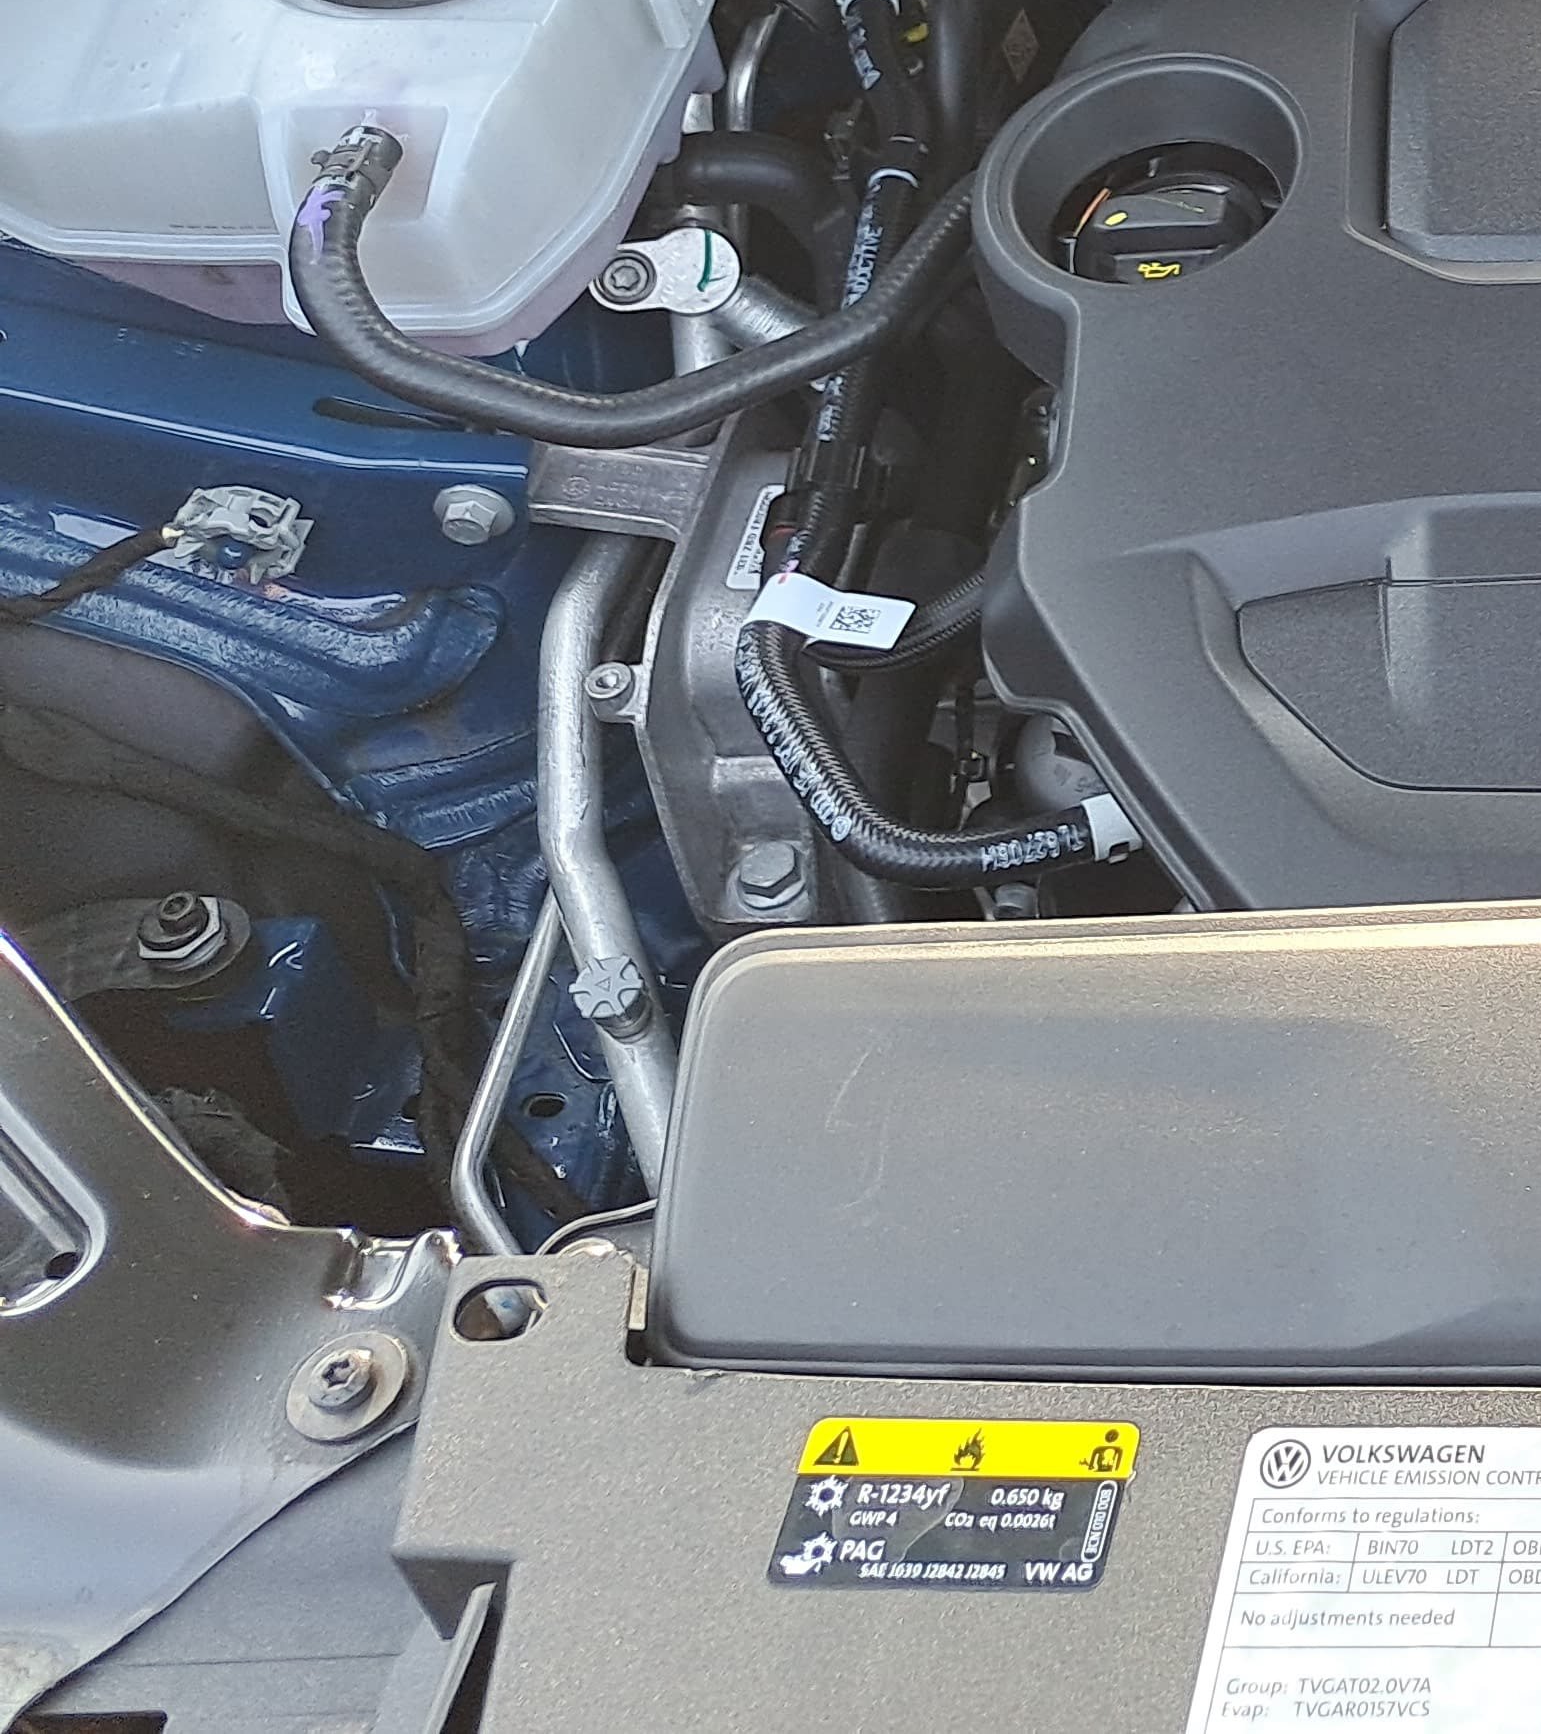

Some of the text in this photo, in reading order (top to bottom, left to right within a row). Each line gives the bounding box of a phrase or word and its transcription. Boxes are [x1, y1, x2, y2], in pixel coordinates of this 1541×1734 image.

[1323, 1445, 1485, 1464] VOLKSWAGEN
[1317, 1470, 1389, 1485] VEHICLE
[1394, 1470, 1481, 1485] EMISSION
[857, 1483, 951, 1510] R-1234yf
[991, 1488, 1064, 1510] 0.650 kg
[850, 1511, 886, 1527] GWP
[979, 1516, 996, 1533] eq
[1262, 1507, 1480, 1528] Conforms to regulations:
[840, 1540, 886, 1560] PAG
[1256, 1539, 1331, 1556] U.S. EPA:
[1368, 1539, 1419, 1556] BIN70
[1451, 1540, 1494, 1556] LDT2
[1025, 1562, 1093, 1581] VW AG
[1249, 1568, 1341, 1586] California:
[1363, 1569, 1427, 1585] ULEV70
[1446, 1569, 1480, 1585] LDT
[1241, 1609, 1456, 1631] No adjustments needed
[1226, 1678, 1288, 1699] Group:
[1221, 1701, 1269, 1723] Evap:
